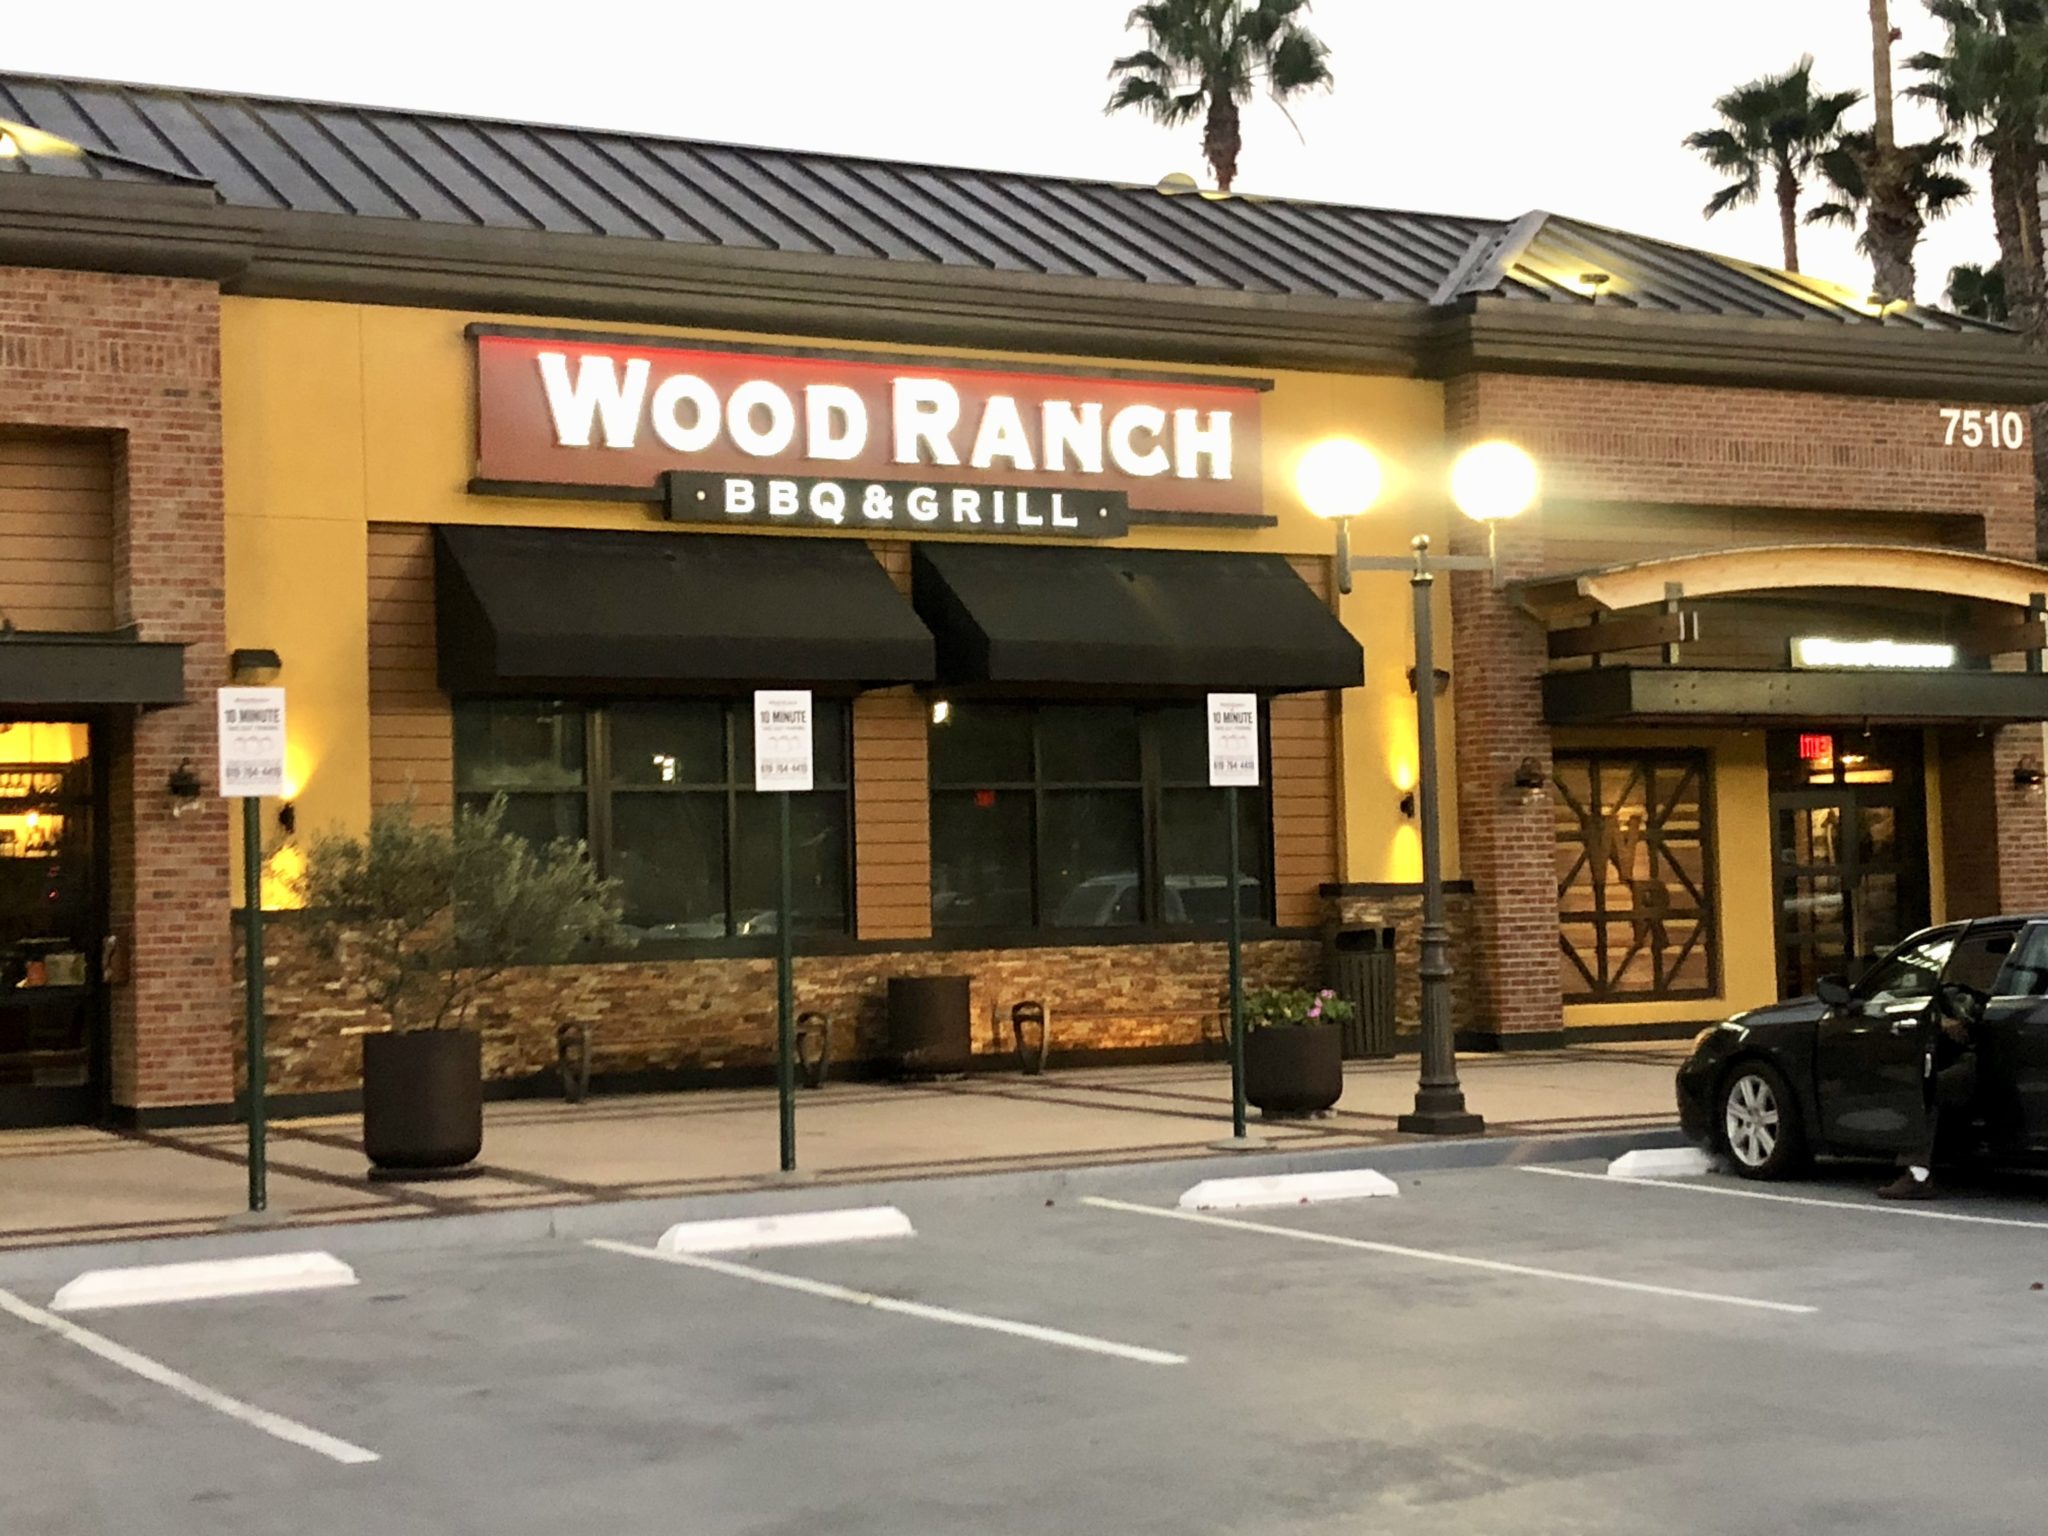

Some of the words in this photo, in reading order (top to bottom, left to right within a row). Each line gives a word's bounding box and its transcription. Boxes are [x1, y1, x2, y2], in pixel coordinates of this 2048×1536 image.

[537, 352, 868, 460] WOOD
[892, 377, 1232, 480] RANCH
[1940, 408, 2023, 449] 7510
[724, 478, 846, 524] BBQ
[906, 486, 1078, 528] GRILL
[239, 709, 280, 723] MINUTE
[760, 711, 770, 723] 10
[773, 710, 806, 723] MINUTE
[1213, 712, 1221, 723] 10
[1223, 711, 1253, 723] MINUTE
